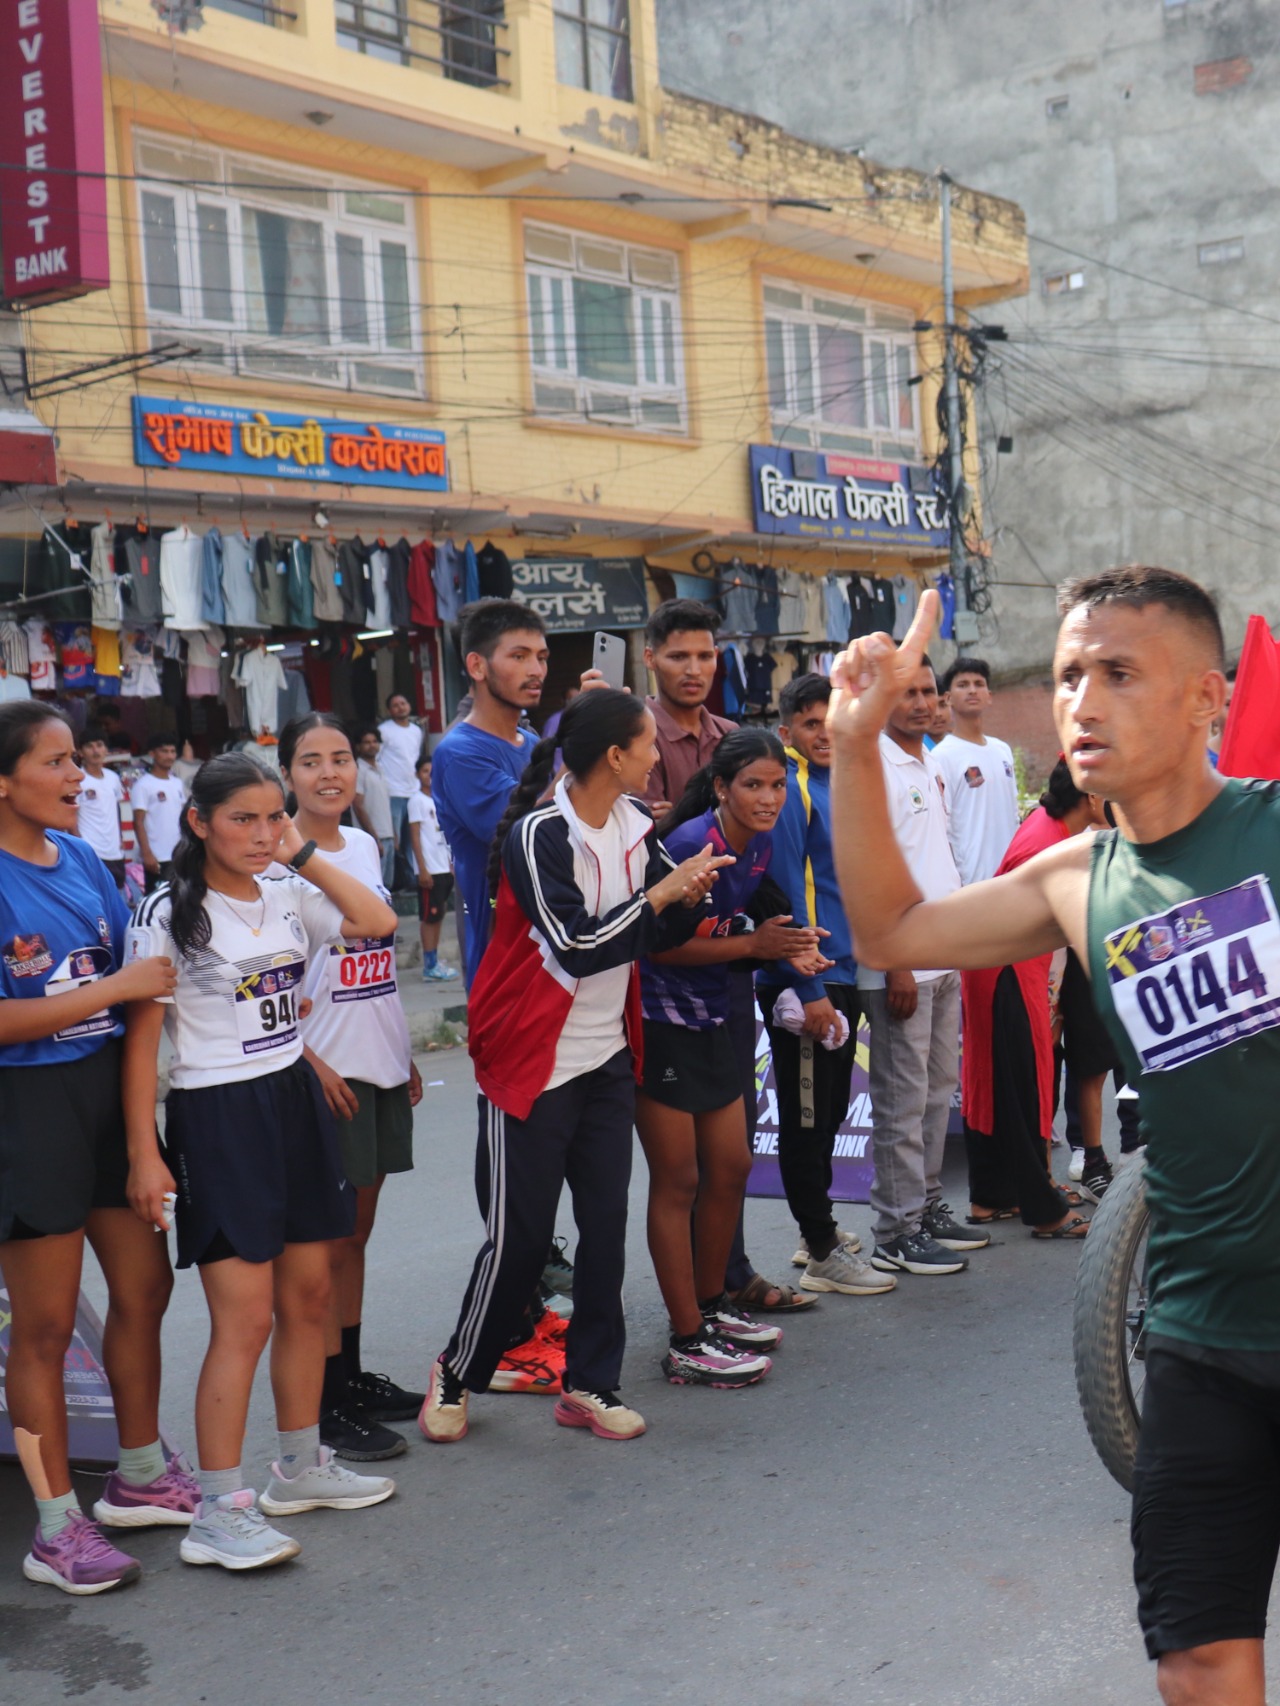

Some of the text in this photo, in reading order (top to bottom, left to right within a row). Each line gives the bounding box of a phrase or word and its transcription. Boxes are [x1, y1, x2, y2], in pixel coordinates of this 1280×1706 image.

[17, 0, 51, 244] EVEREST
[15, 246, 68, 282] BANK
[239, 411, 326, 466] फेन्सी
[329, 424, 446, 477] कलेक्सन
[761, 464, 839, 521] हिमाल
[844, 475, 910, 527] फेन्सी
[341, 949, 392, 988] 0222
[1136, 935, 1268, 1037] 0144
[832, 1134, 870, 1158] RINK
